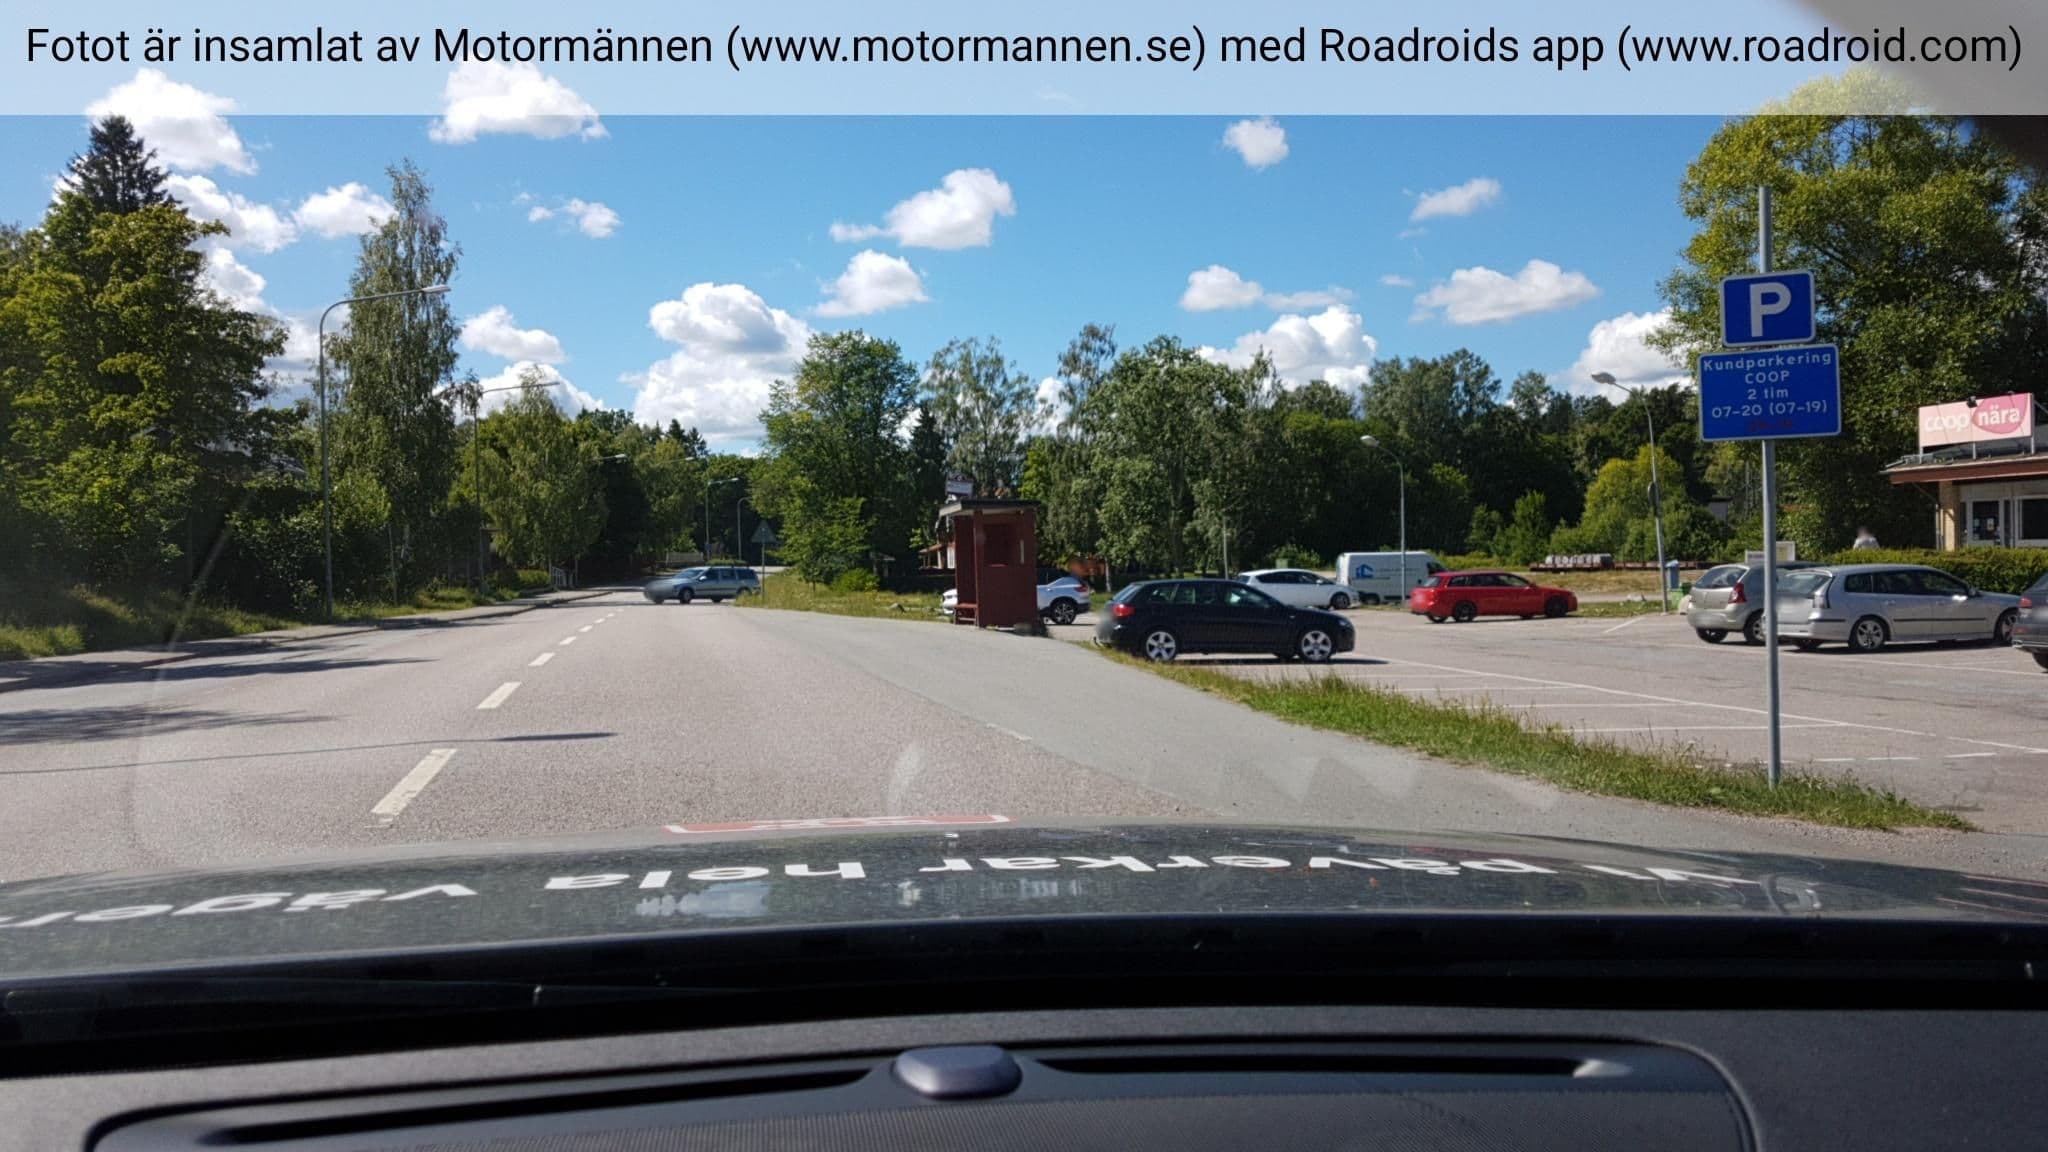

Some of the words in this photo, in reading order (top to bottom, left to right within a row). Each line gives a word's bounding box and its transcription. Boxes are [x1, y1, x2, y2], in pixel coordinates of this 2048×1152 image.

[1750, 282, 1791, 337] P
[1704, 353, 1831, 370] Kundparkering
[1745, 370, 1790, 384] COOP
[1747, 388, 1757, 400] 2
[1764, 386, 1789, 399] tim
[1711, 404, 1763, 418] 07-20
[1768, 399, 1828, 416] (07-19)
[1926, 413, 1969, 432] coop
[1979, 405, 2019, 425] nära
[544, 861, 866, 889] hela
[919, 856, 1558, 875] påverkar
